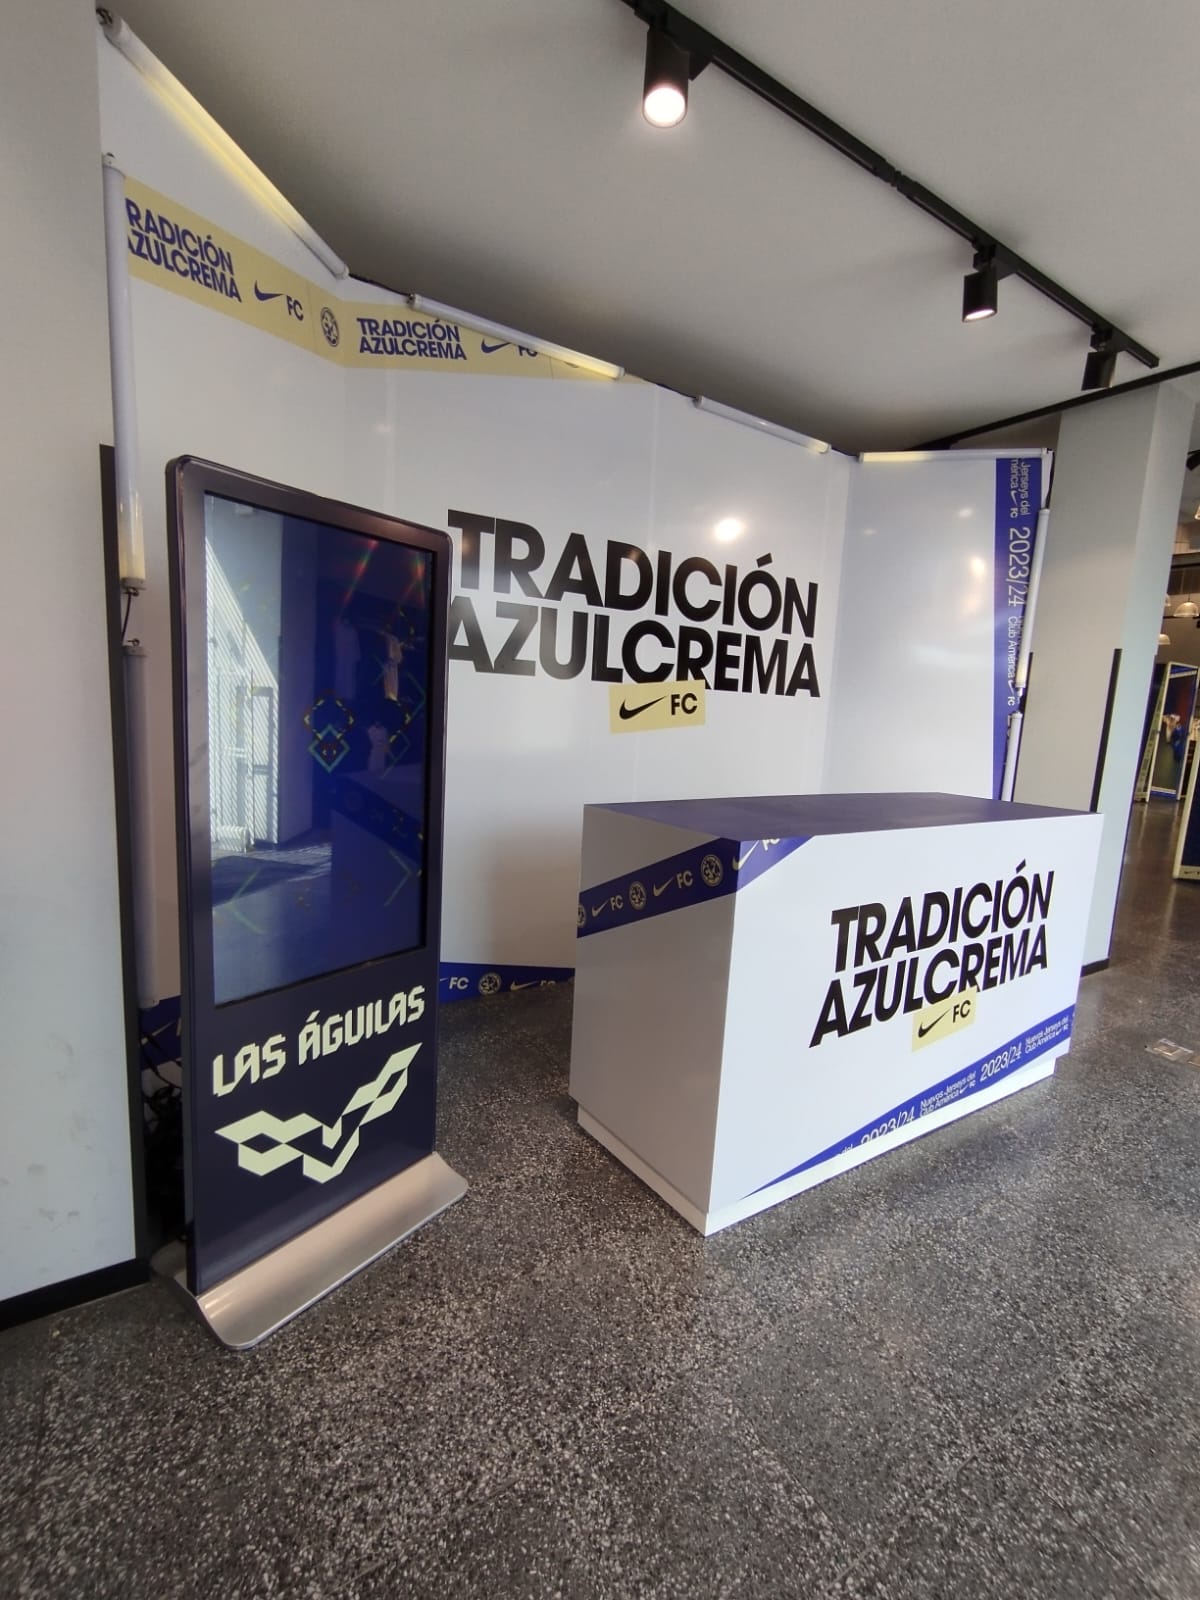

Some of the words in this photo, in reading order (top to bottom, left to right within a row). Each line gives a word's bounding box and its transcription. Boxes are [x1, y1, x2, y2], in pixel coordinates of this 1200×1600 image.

[125, 198, 234, 274] RADICIÓN
[127, 229, 243, 303] ZULCREMA
[286, 295, 304, 322] FC
[356, 316, 461, 343] TRADICIÓN
[359, 336, 468, 361] AZULCREMA
[1018, 461, 1031, 499] Jerseys
[1020, 500, 1031, 516] del
[447, 508, 819, 639] TRADICIÓN
[1006, 527, 1031, 608] 2023/24
[447, 595, 821, 698] AZULCREMA
[1008, 616, 1018, 639] Club
[670, 692, 698, 716] FC
[610, 894, 624, 911] FC
[677, 870, 694, 889] FC
[830, 858, 1055, 973] TRADICIÓN
[449, 976, 469, 990] FC
[808, 923, 1048, 1048] AZULCREMA
[952, 999, 972, 1024] FC
[212, 1033, 287, 1098] LAS
[298, 984, 426, 1066] ÁGUILAS
[980, 1041, 1022, 1082] 2023/24
